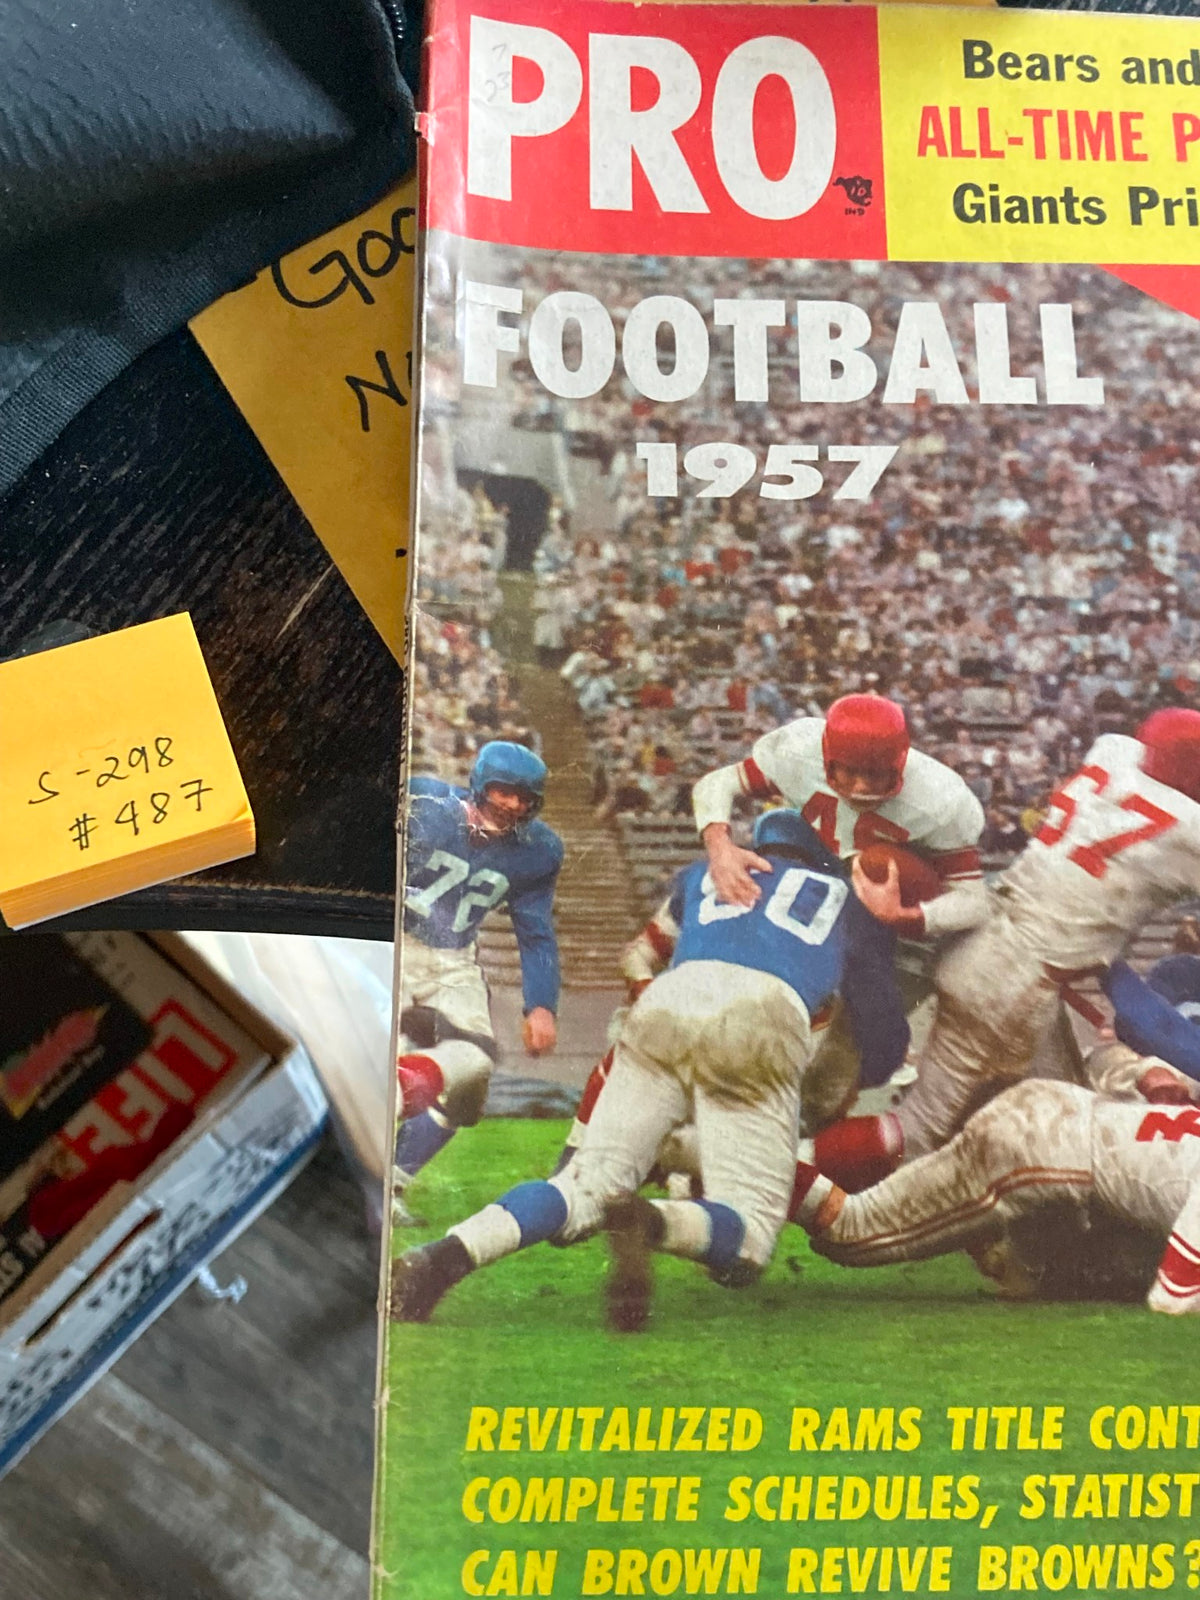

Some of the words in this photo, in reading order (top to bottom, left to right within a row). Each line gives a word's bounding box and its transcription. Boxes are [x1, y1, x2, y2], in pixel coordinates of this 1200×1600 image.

[962, 39, 1101, 83] Bears
[1121, 49, 1200, 86] and
[466, 14, 838, 221] PRO
[917, 105, 1149, 162] ALL-TIME
[952, 182, 1107, 226] Giants
[1128, 186, 1200, 227] Pri
[462, 280, 1105, 405] FOOTBALL
[636, 442, 900, 500] 1957
[404, 848, 510, 933] 72
[465, 1406, 763, 1452] REVITALIZED
[789, 1406, 922, 1451] RAMS
[947, 1406, 1065, 1450] TITLE
[1090, 1405, 1200, 1450] CONT
[461, 1476, 701, 1523] COMPLETE
[724, 1475, 999, 1529] SCHEDULES,
[1019, 1473, 1200, 1520] STATIST
[461, 1549, 558, 1596] CAN
[581, 1548, 761, 1596] BROWN
[786, 1546, 952, 1594] REVIVE
